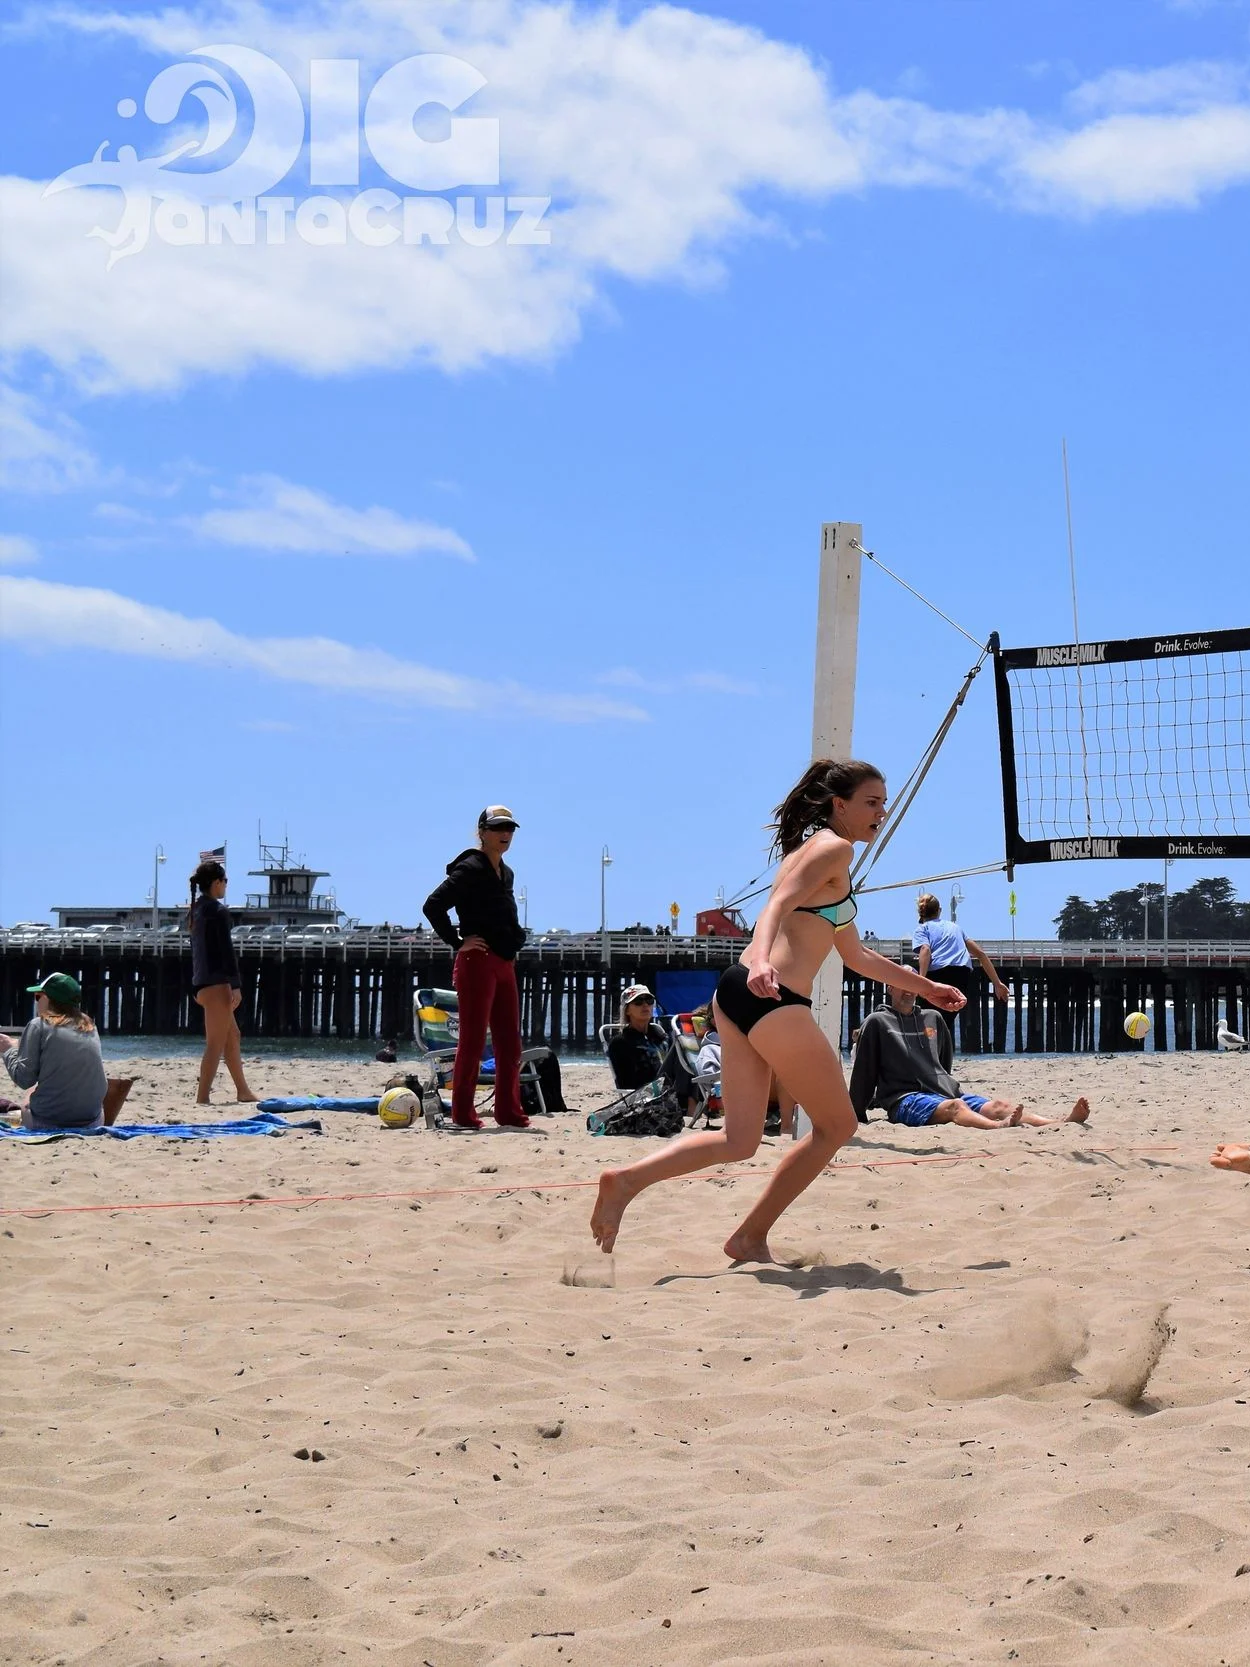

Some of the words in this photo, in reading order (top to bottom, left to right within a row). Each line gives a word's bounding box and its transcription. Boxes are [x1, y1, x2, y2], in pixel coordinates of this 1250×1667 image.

[1036, 644, 1078, 666] MUSCLE
[1079, 644, 1106, 663] MILK
[1154, 638, 1183, 654] Drink.
[1050, 839, 1092, 860] MUSCLE
[1091, 838, 1119, 858] MILK
[1168, 841, 1197, 855] Drink.
